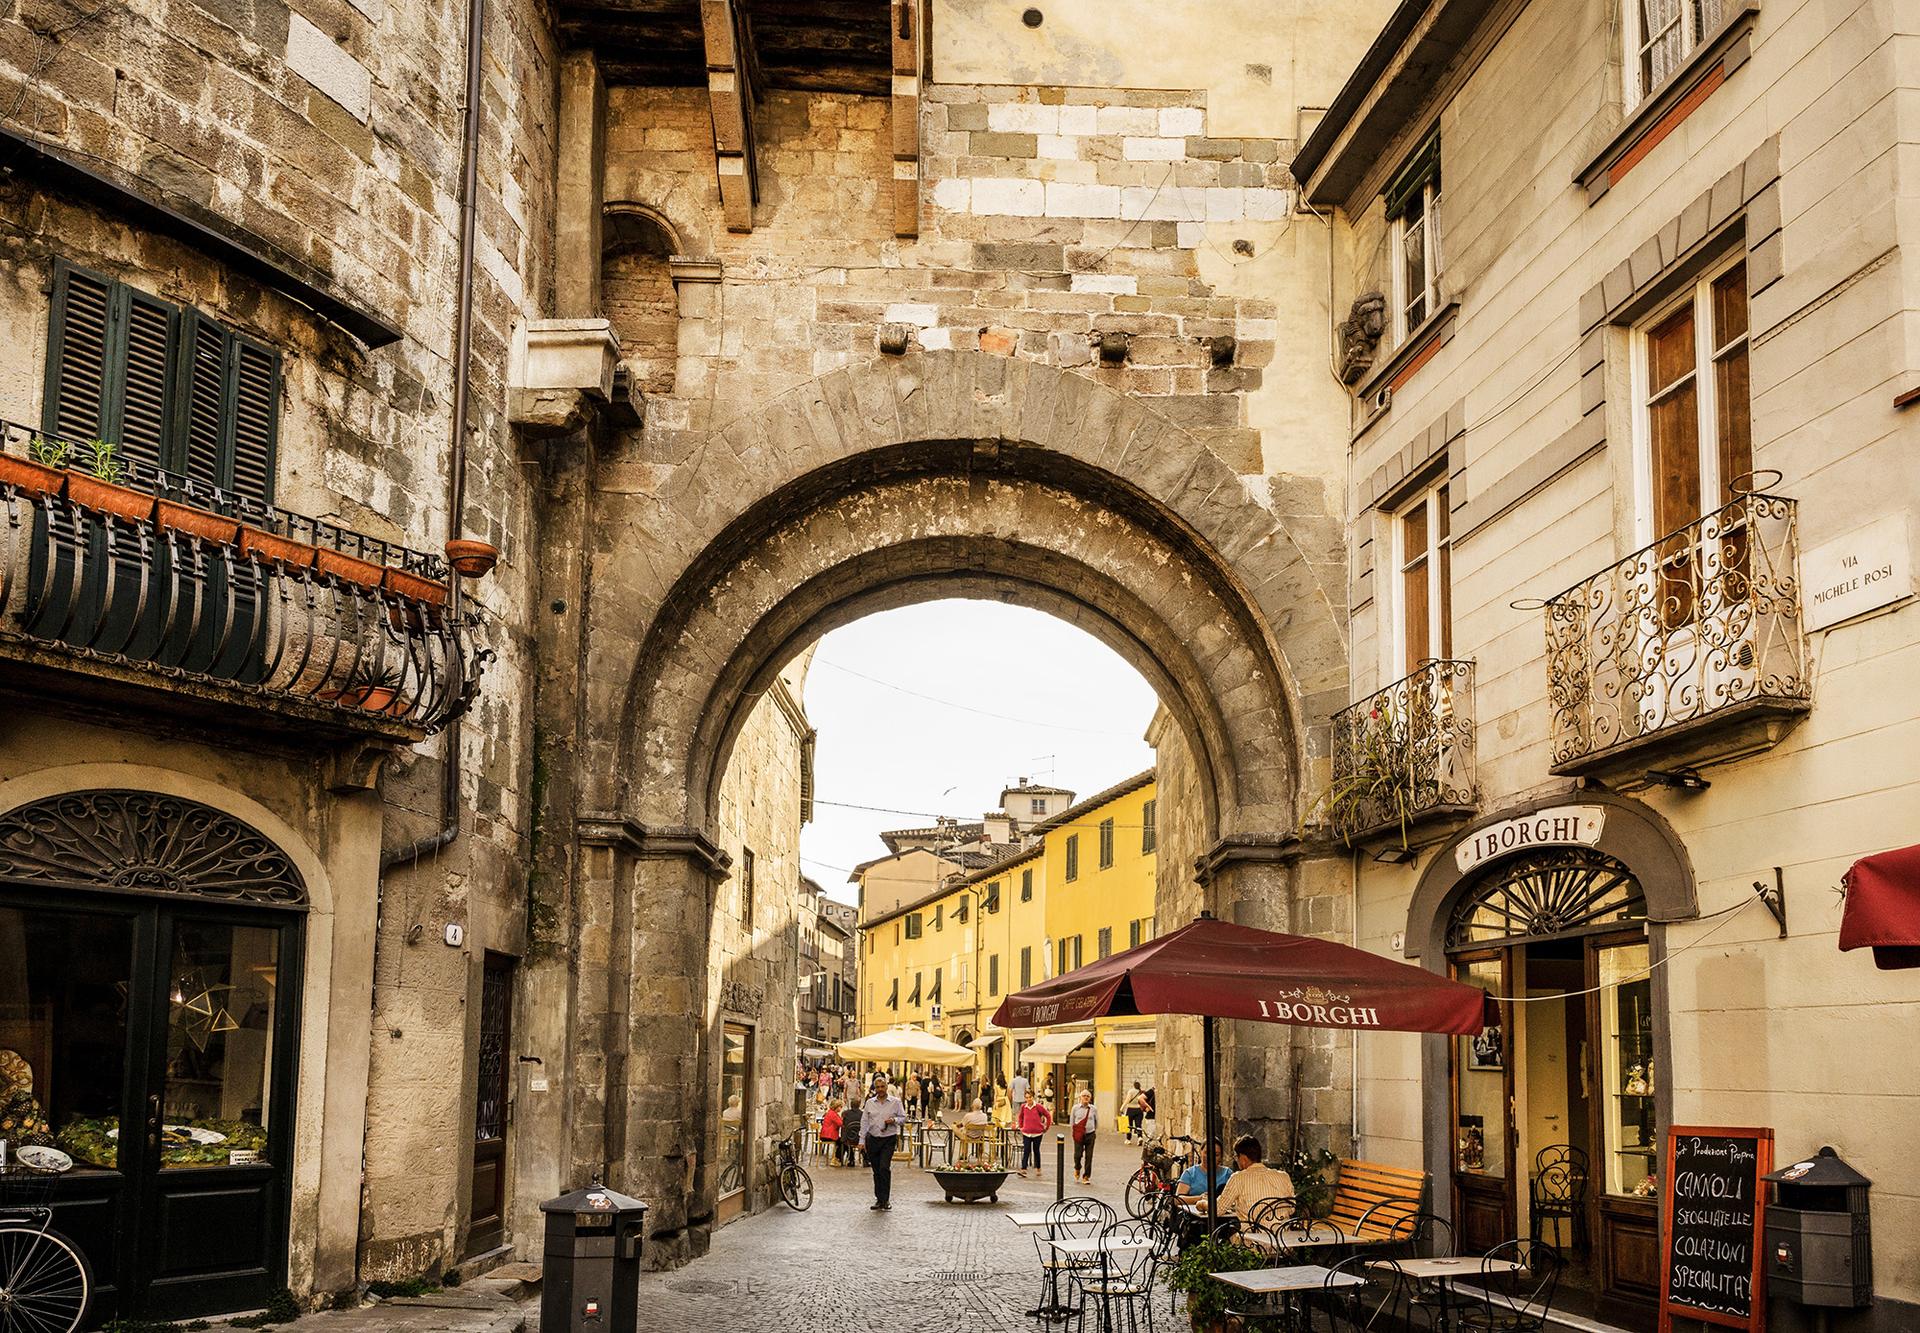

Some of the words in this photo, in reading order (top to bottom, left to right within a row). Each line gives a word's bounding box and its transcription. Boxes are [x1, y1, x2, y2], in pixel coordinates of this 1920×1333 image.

[1842, 556, 1858, 570] VIA
[1814, 578, 1859, 604] MICHELE
[1864, 564, 1893, 586] ROSI
[1474, 838, 1482, 862] I
[1486, 816, 1580, 857] BORGHI
[1394, 933, 1401, 949] 3
[1035, 1003, 1060, 1022] BORGHI
[1258, 1000, 1270, 1017] I
[1274, 1001, 1380, 1025] BORGHI
[1675, 1171, 1742, 1200] CANNOLI
[1677, 1207, 1754, 1228] SFOGLIATELLE
[1675, 1235, 1745, 1263] COLAZIONI
